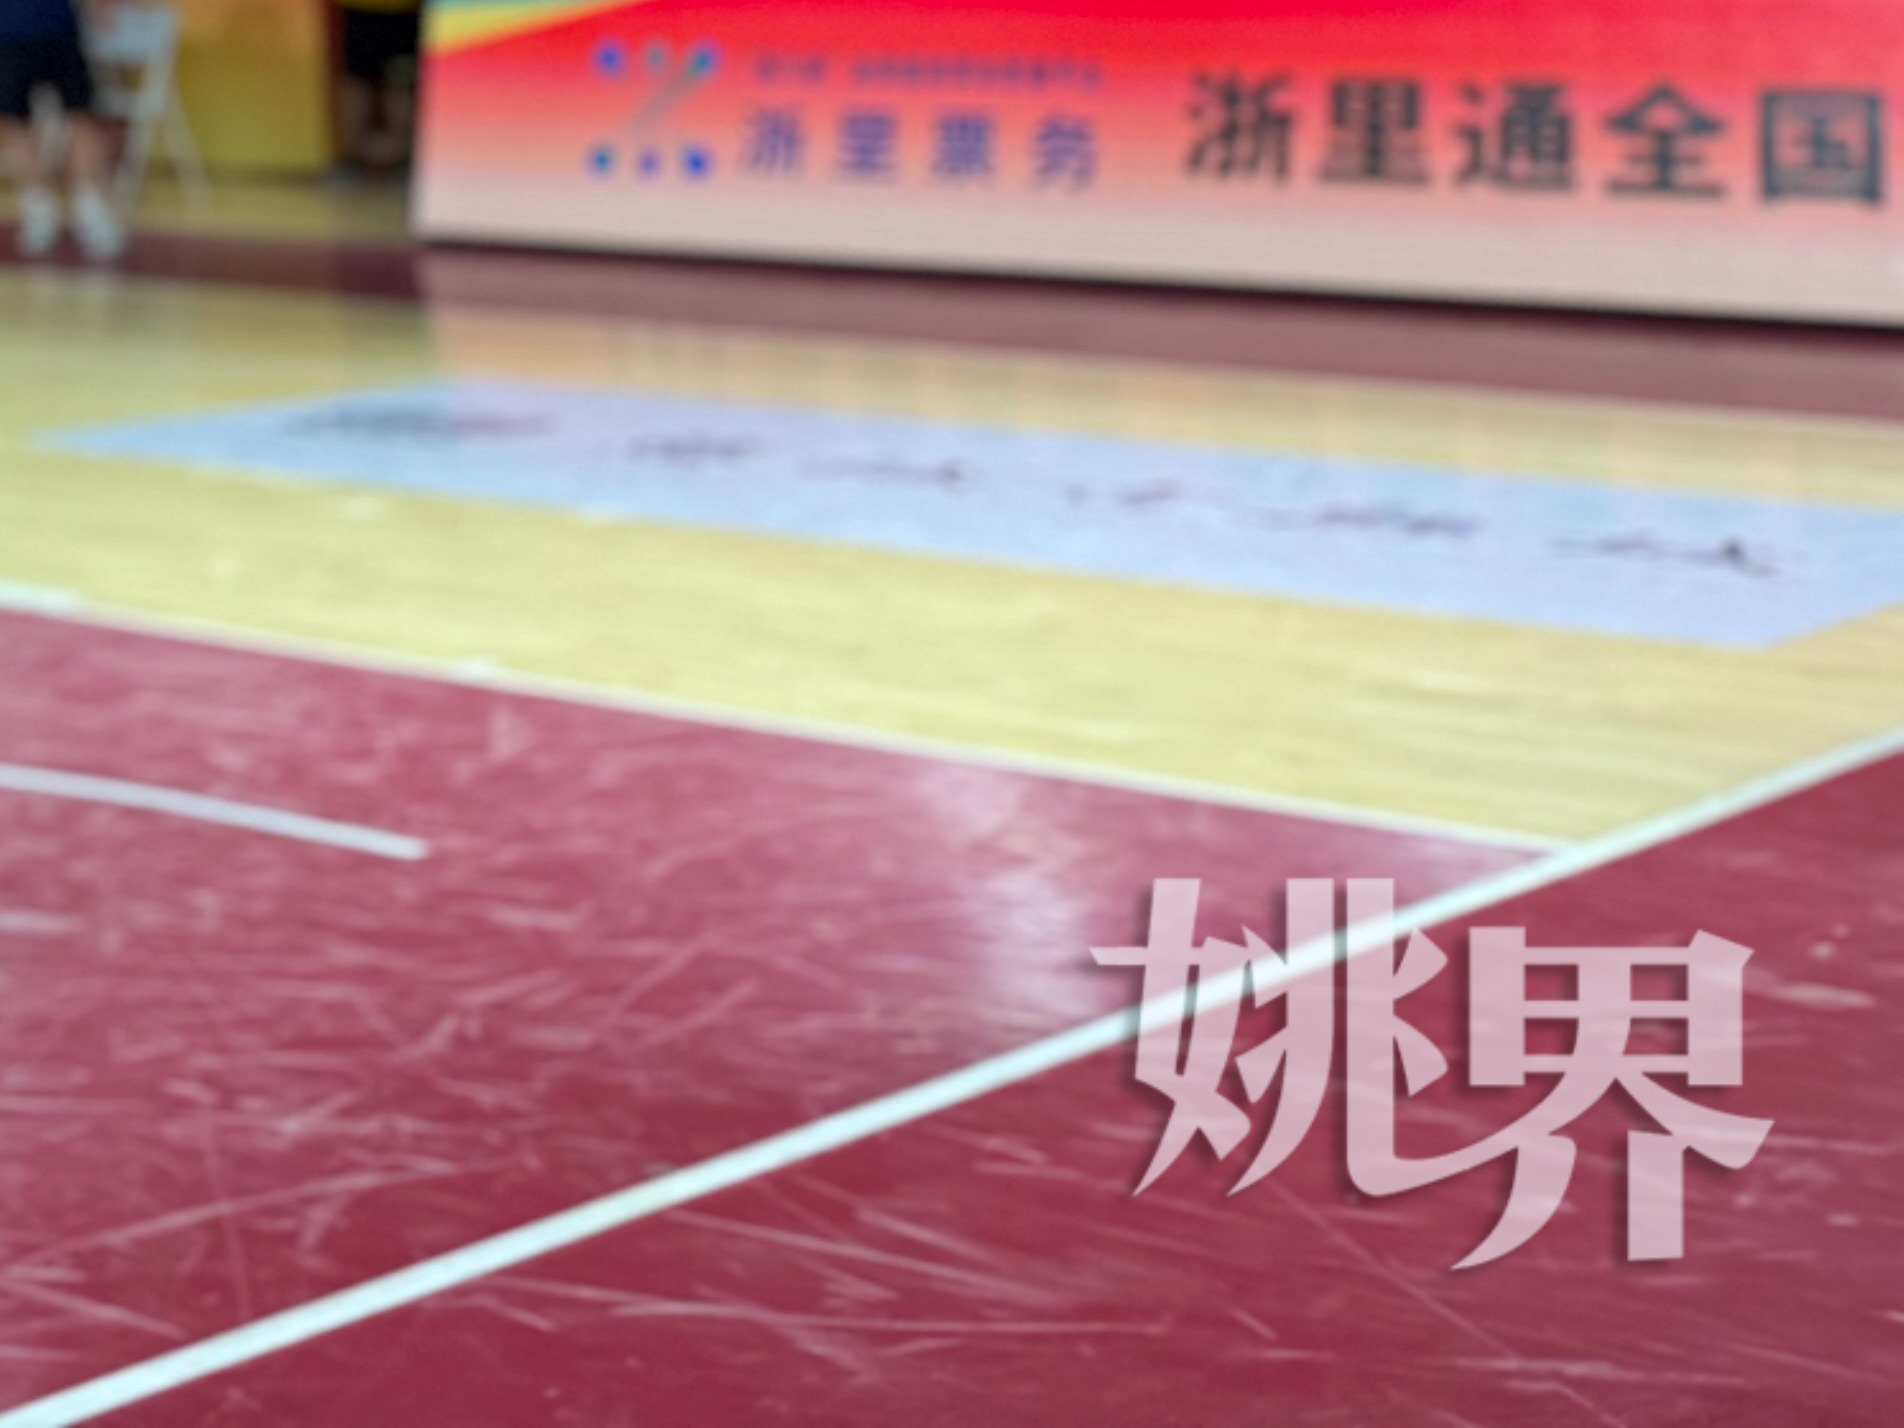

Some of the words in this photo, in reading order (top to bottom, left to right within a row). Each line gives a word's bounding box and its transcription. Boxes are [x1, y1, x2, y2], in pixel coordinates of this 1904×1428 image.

[1184, 70, 1886, 208] 浙里通全国
